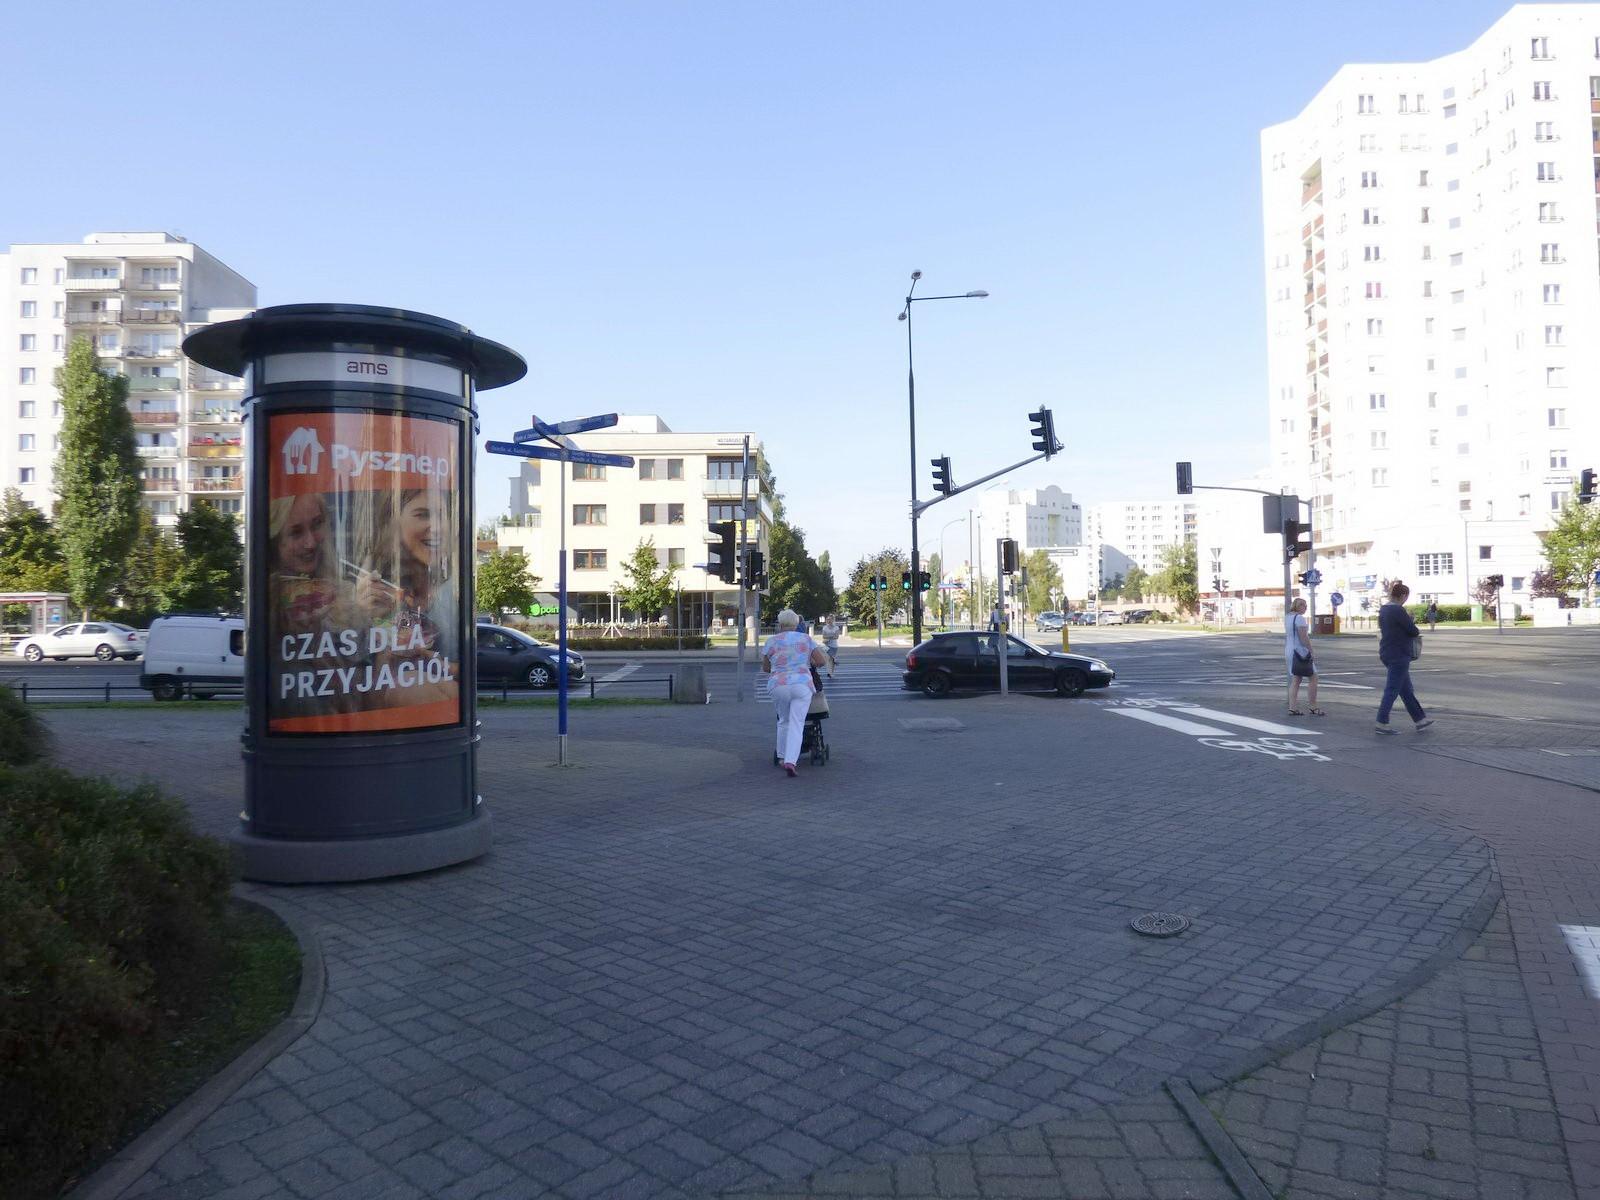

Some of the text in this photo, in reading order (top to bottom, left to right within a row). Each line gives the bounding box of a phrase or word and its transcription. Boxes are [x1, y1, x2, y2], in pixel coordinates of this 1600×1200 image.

[346, 360, 388, 376] ams
[331, 444, 450, 482] Pyszne.p
[540, 605, 560, 616] poin
[282, 624, 427, 662] CZAS DLA
[281, 651, 454, 700] PRZYJACIÓŁ
